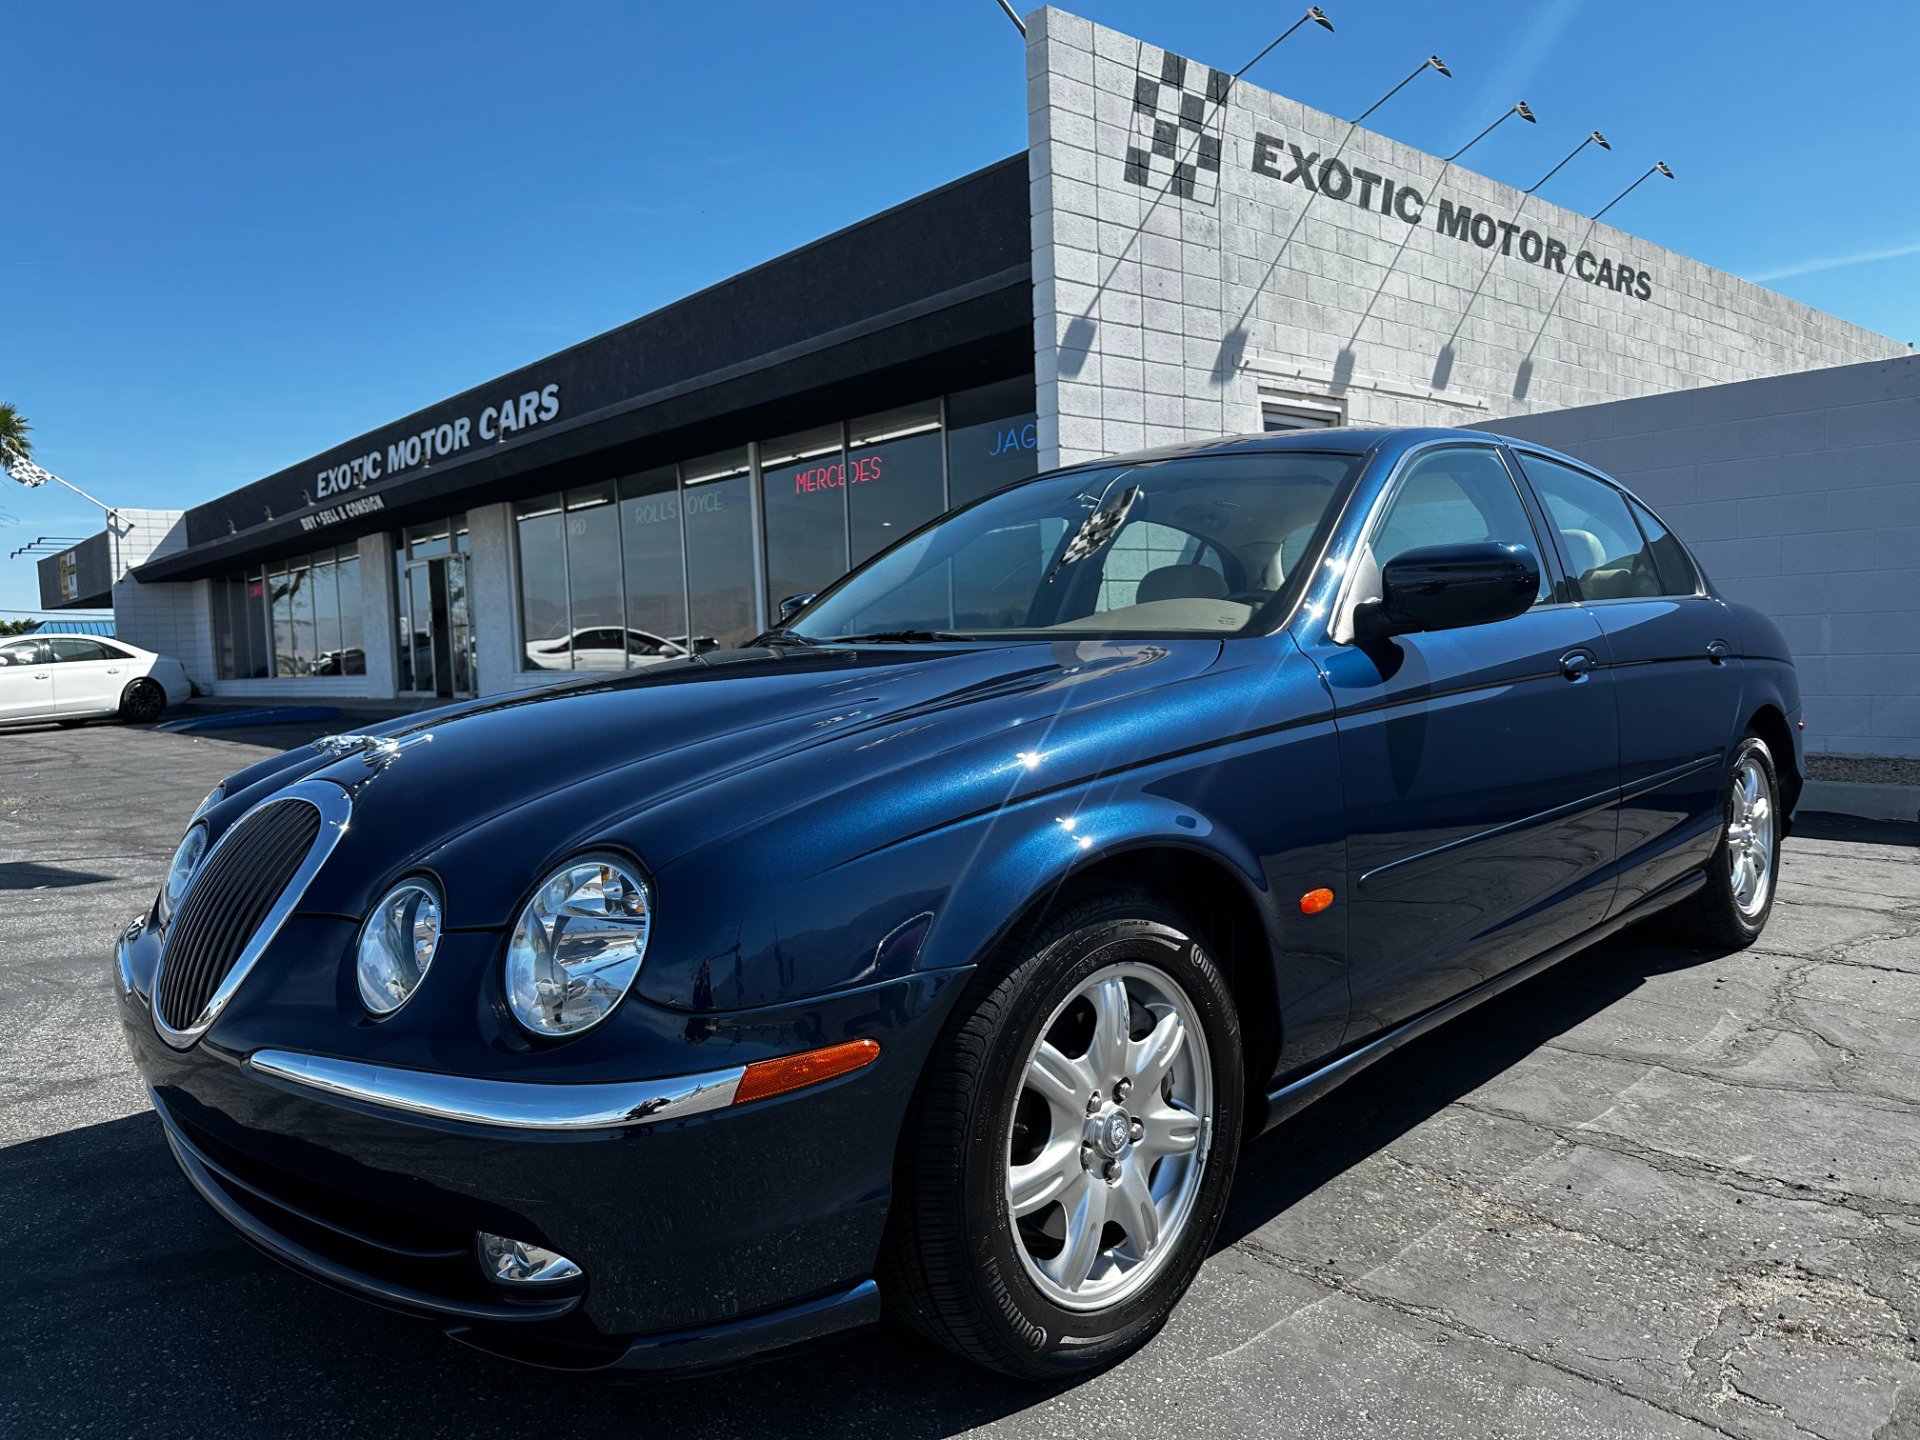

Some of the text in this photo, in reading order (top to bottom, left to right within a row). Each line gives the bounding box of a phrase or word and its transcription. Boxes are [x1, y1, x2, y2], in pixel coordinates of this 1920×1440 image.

[1252, 131, 1651, 301] EXOTIC MOTOR CARS
[317, 383, 560, 498] EXOTIC MOTOR CARS
[299, 514, 318, 531] BUY
[319, 508, 340, 525] SELL
[345, 494, 385, 518] CONSIGN
[635, 491, 723, 525] ROLLS OYCE
[1190, 943, 1238, 1037] Continental
[979, 1255, 1048, 1352] Continental
